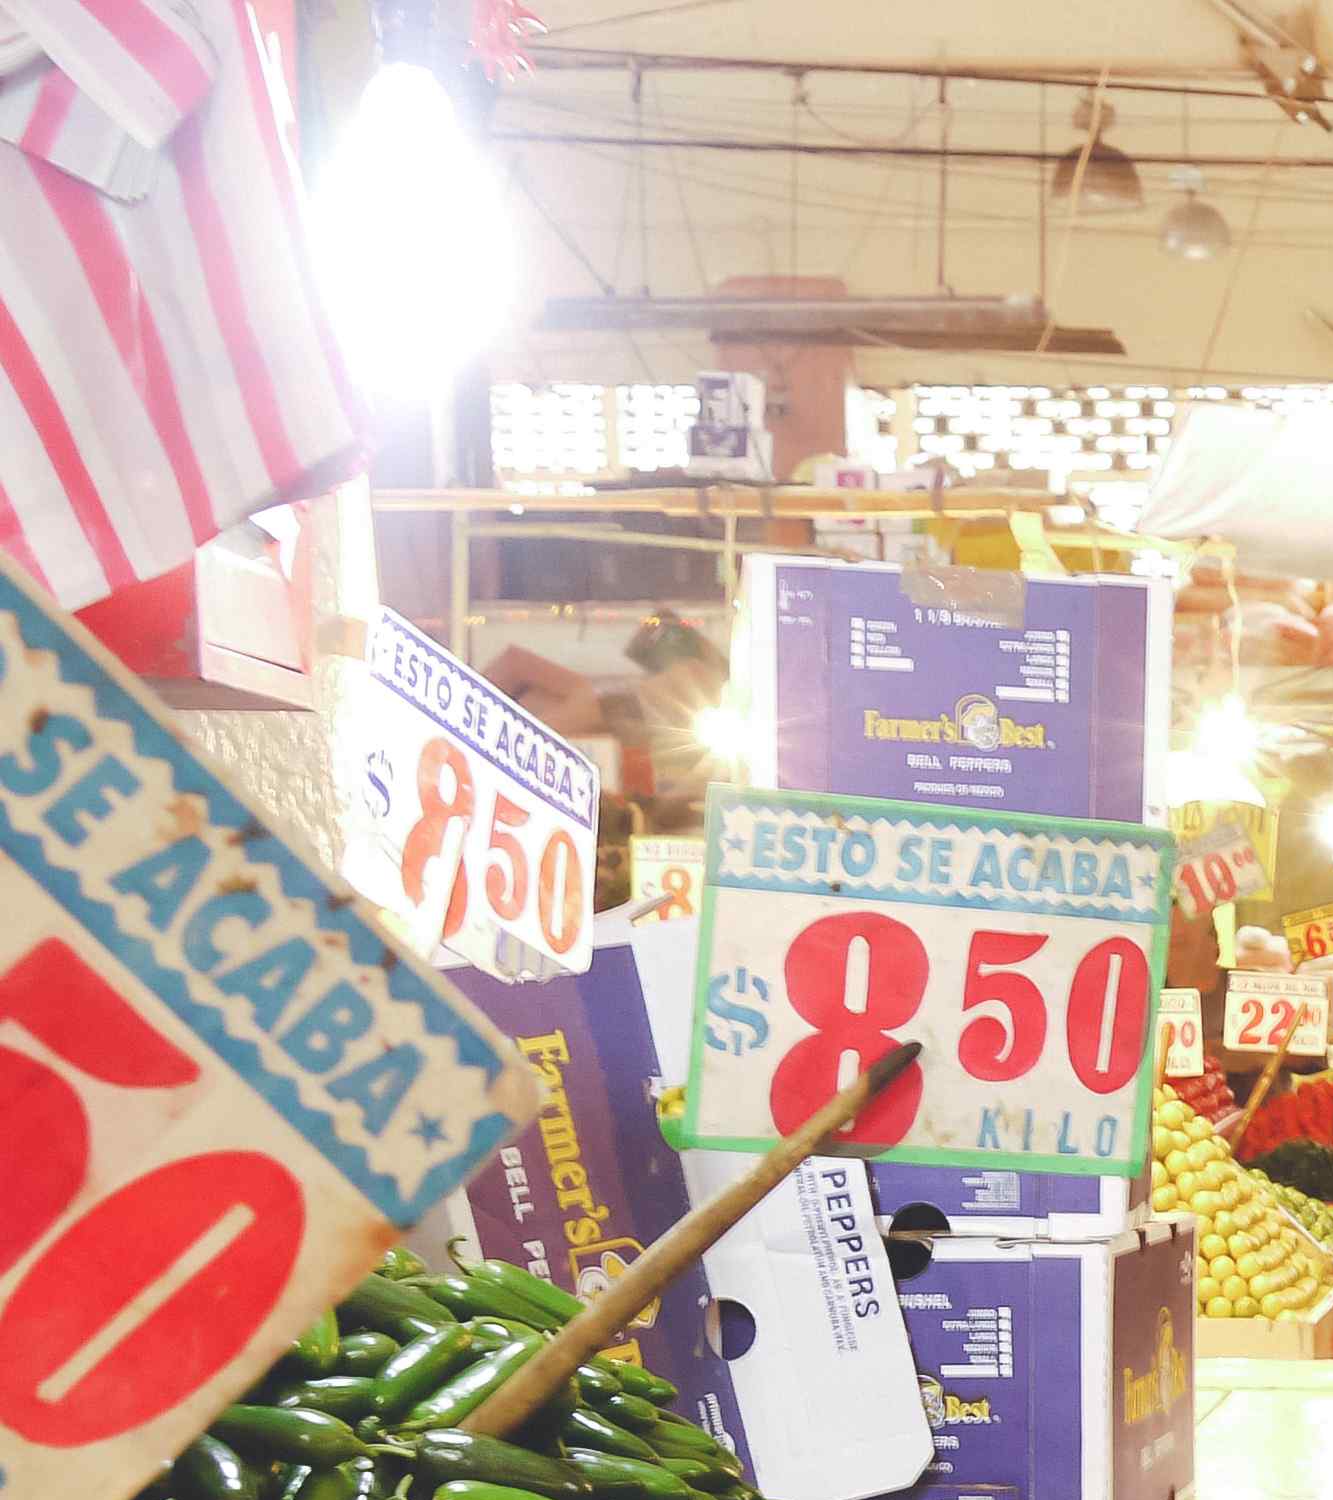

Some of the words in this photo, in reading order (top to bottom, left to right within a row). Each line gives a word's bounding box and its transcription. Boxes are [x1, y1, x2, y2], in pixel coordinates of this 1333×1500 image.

[394, 641, 452, 711] ESTO
[463, 694, 489, 740] SE
[496, 722, 574, 803] ACABA
[751, 820, 877, 877] ESTO
[896, 836, 953, 885] SE
[970, 841, 1132, 899] ACABA
[2, 712, 140, 846] SE
[110, 830, 424, 1140] ACABA
[977, 1107, 1119, 1158] KILO
[821, 1167, 880, 1319] PEPPERS
[944, 1395, 990, 1424] Best
